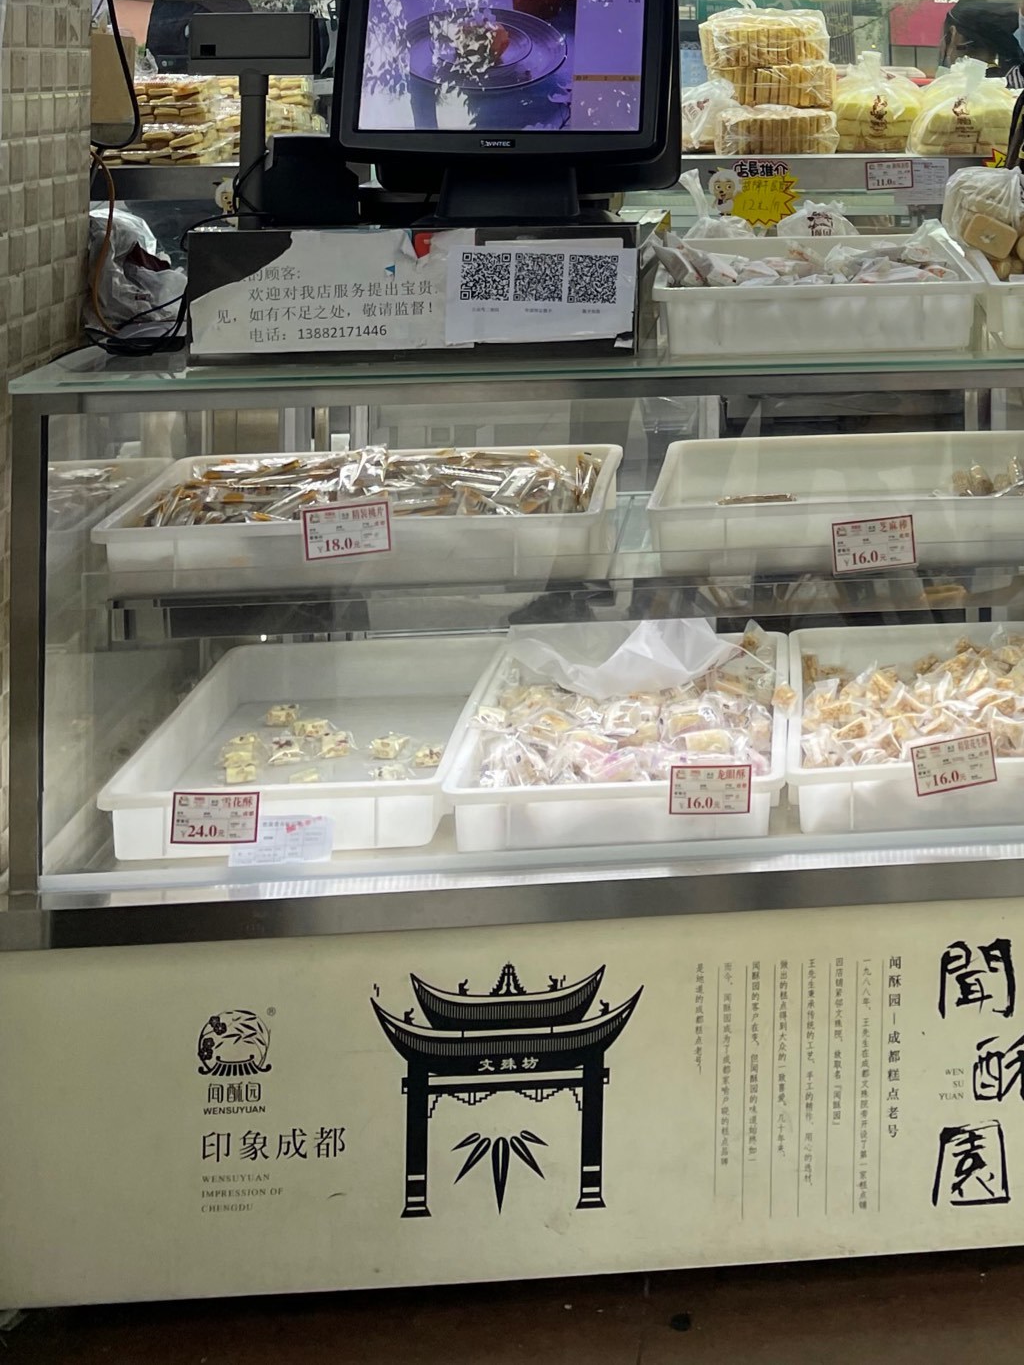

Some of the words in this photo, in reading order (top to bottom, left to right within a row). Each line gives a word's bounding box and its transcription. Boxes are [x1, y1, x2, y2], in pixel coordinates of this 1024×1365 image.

[243, 265, 302, 283] 的顾客：
[249, 280, 438, 302] 欢迎对我店服务提出宝贵
[221, 796, 253, 808] 雪花酥
[477, 1057, 540, 1073] 文殊坊
[944, 1067, 965, 1076] WEN
[952, 1080, 965, 1089] SU
[207, 1081, 262, 1104] 闻酥园
[938, 1092, 965, 1101] YUAN
[203, 1105, 266, 1115] WENSUYUAN
[201, 1126, 346, 1163] 印象成都
[202, 1173, 271, 1184] WENSUYUAN
[201, 1188, 267, 1199] IMPRESSION
[270, 1187, 284, 1196] OF
[201, 1202, 253, 1213] CHENGDU
